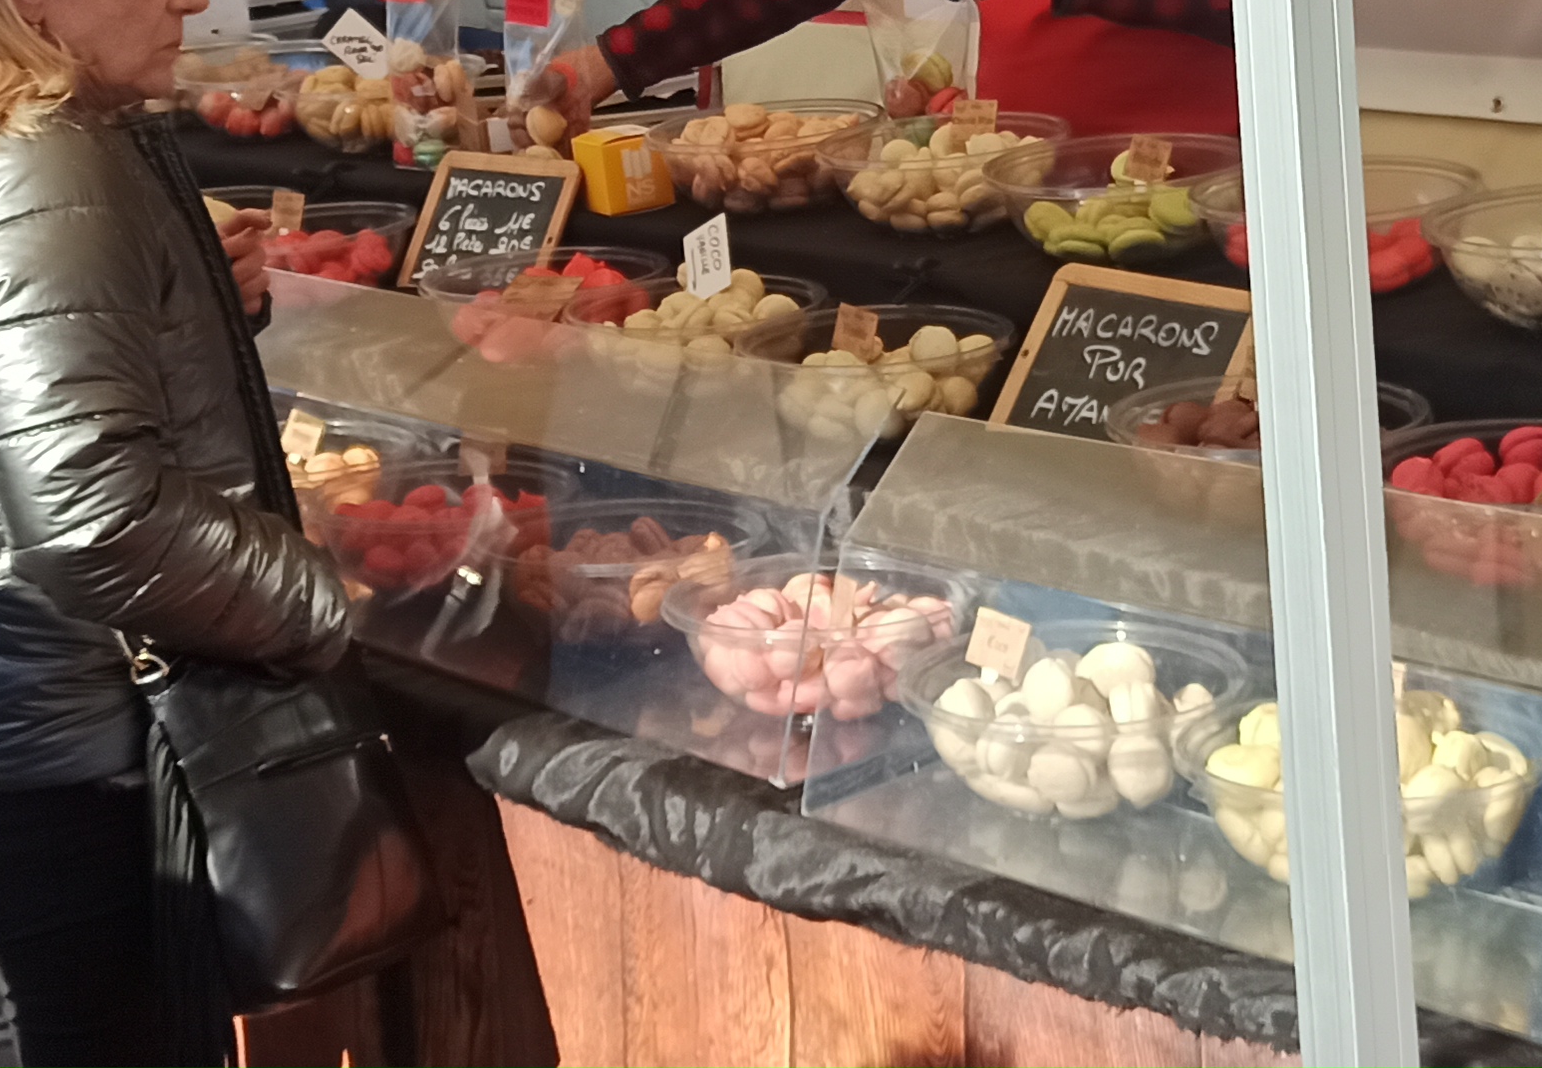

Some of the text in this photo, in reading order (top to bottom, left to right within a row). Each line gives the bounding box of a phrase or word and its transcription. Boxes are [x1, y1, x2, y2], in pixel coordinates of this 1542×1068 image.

[445, 176, 546, 202] MACARONS
[707, 224, 722, 271] COCO
[1051, 305, 1220, 356] MACARONS
[1082, 344, 1147, 390] PUR
